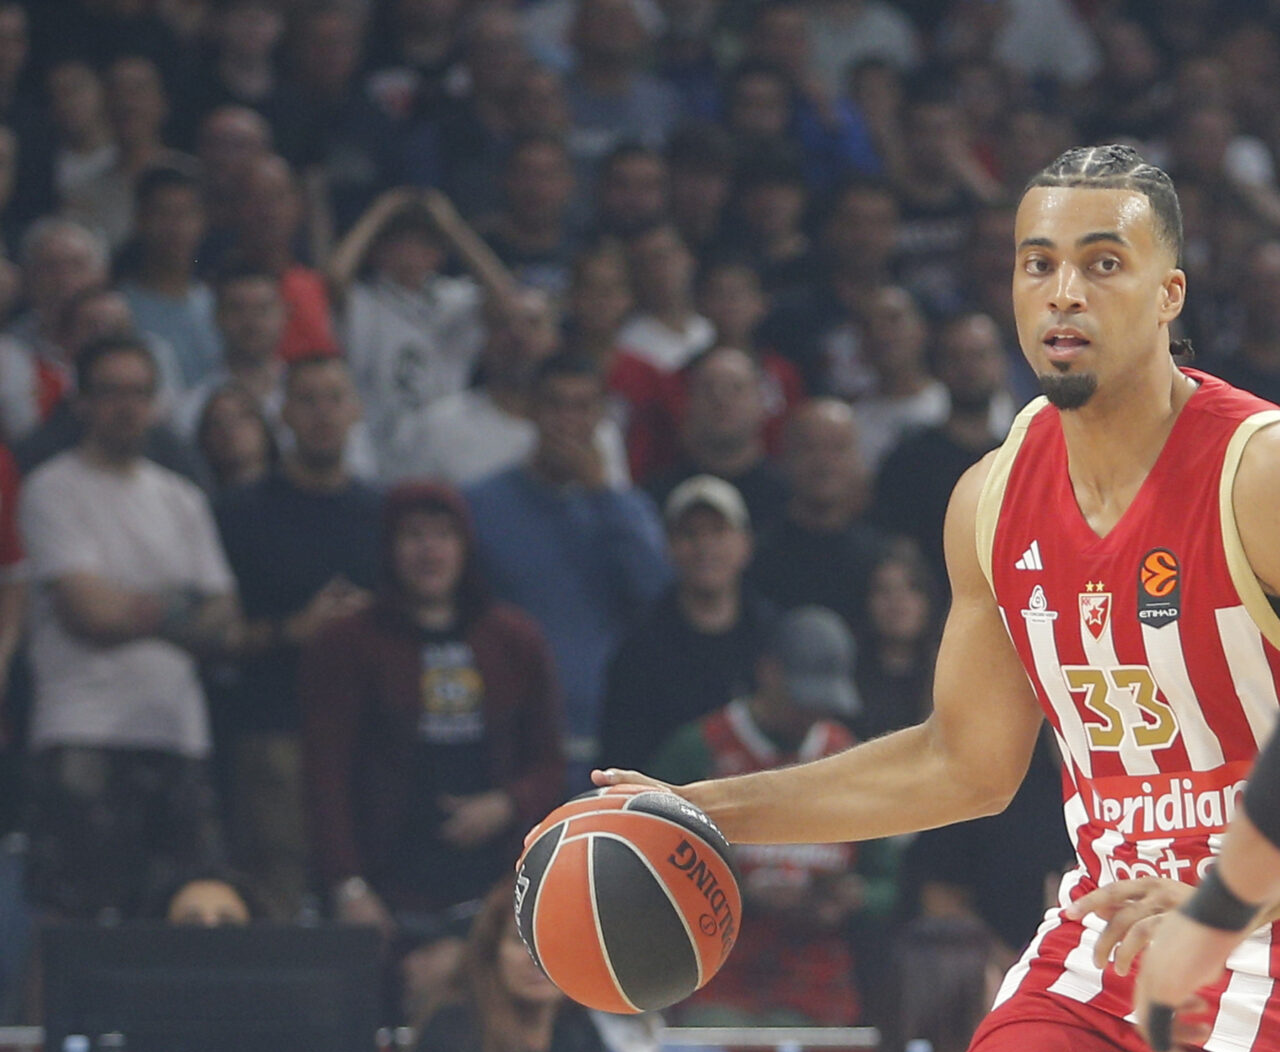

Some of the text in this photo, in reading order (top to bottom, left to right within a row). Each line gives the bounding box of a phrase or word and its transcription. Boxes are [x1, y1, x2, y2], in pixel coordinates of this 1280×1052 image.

[1138, 608, 1178, 619] ETIHAD
[1061, 665, 1180, 751] 33
[667, 839, 735, 955] ALDING
